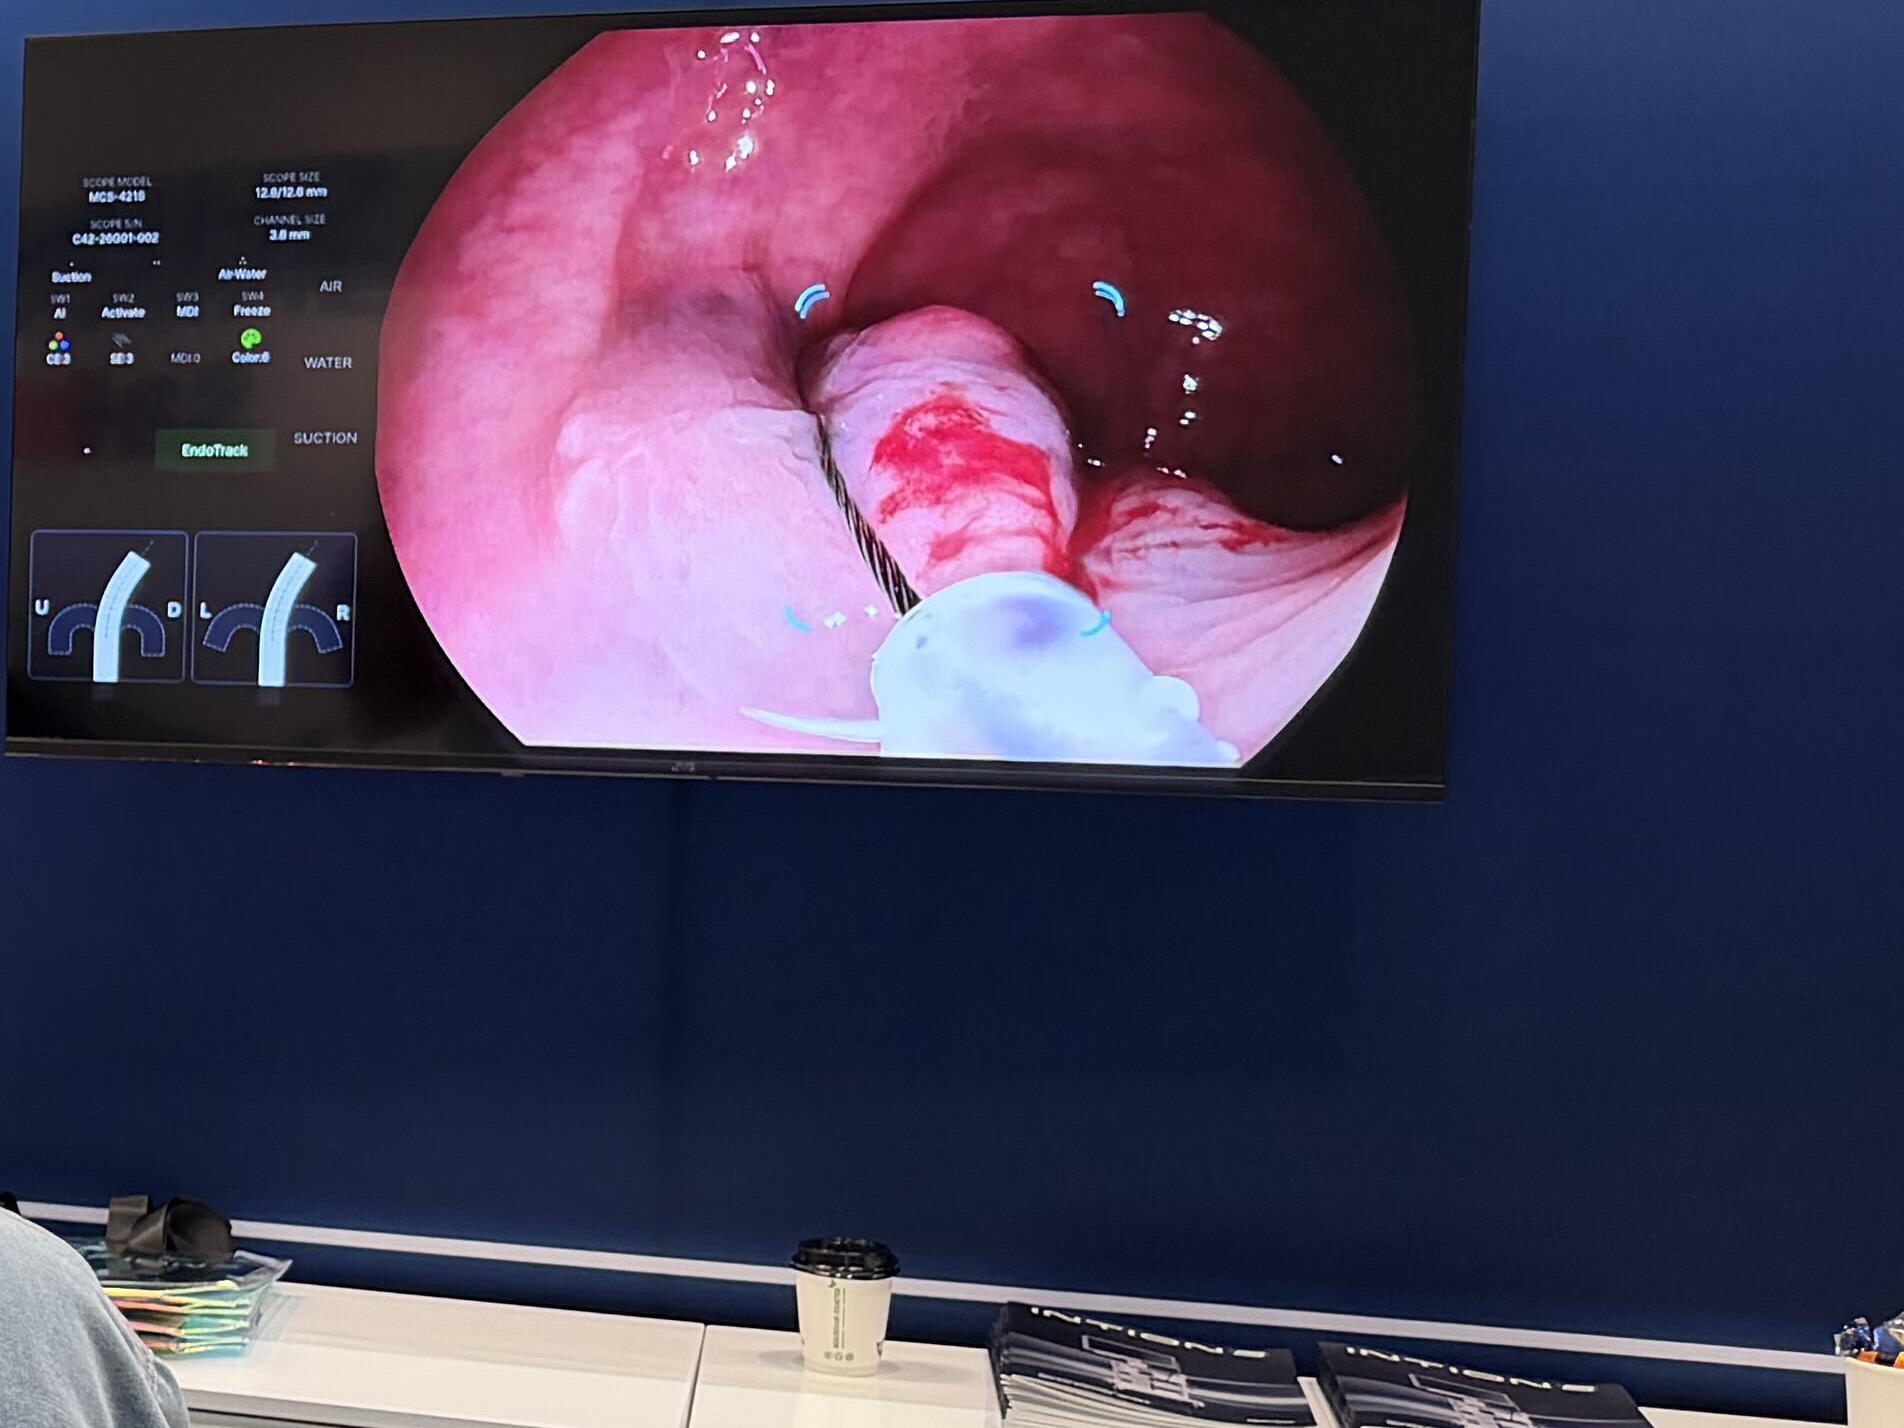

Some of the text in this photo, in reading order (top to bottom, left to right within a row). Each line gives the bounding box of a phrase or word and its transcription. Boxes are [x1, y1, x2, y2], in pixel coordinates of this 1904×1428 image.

[319, 280, 343, 293] AIR
[100, 307, 146, 319] Activate
[233, 305, 272, 317] Freeze
[303, 356, 353, 370] WATER
[293, 431, 358, 445] SUCTION
[181, 443, 249, 459] EndoTrack
[34, 598, 50, 616] U
[167, 601, 182, 619] D
[199, 601, 213, 620] L
[336, 603, 352, 622] R
